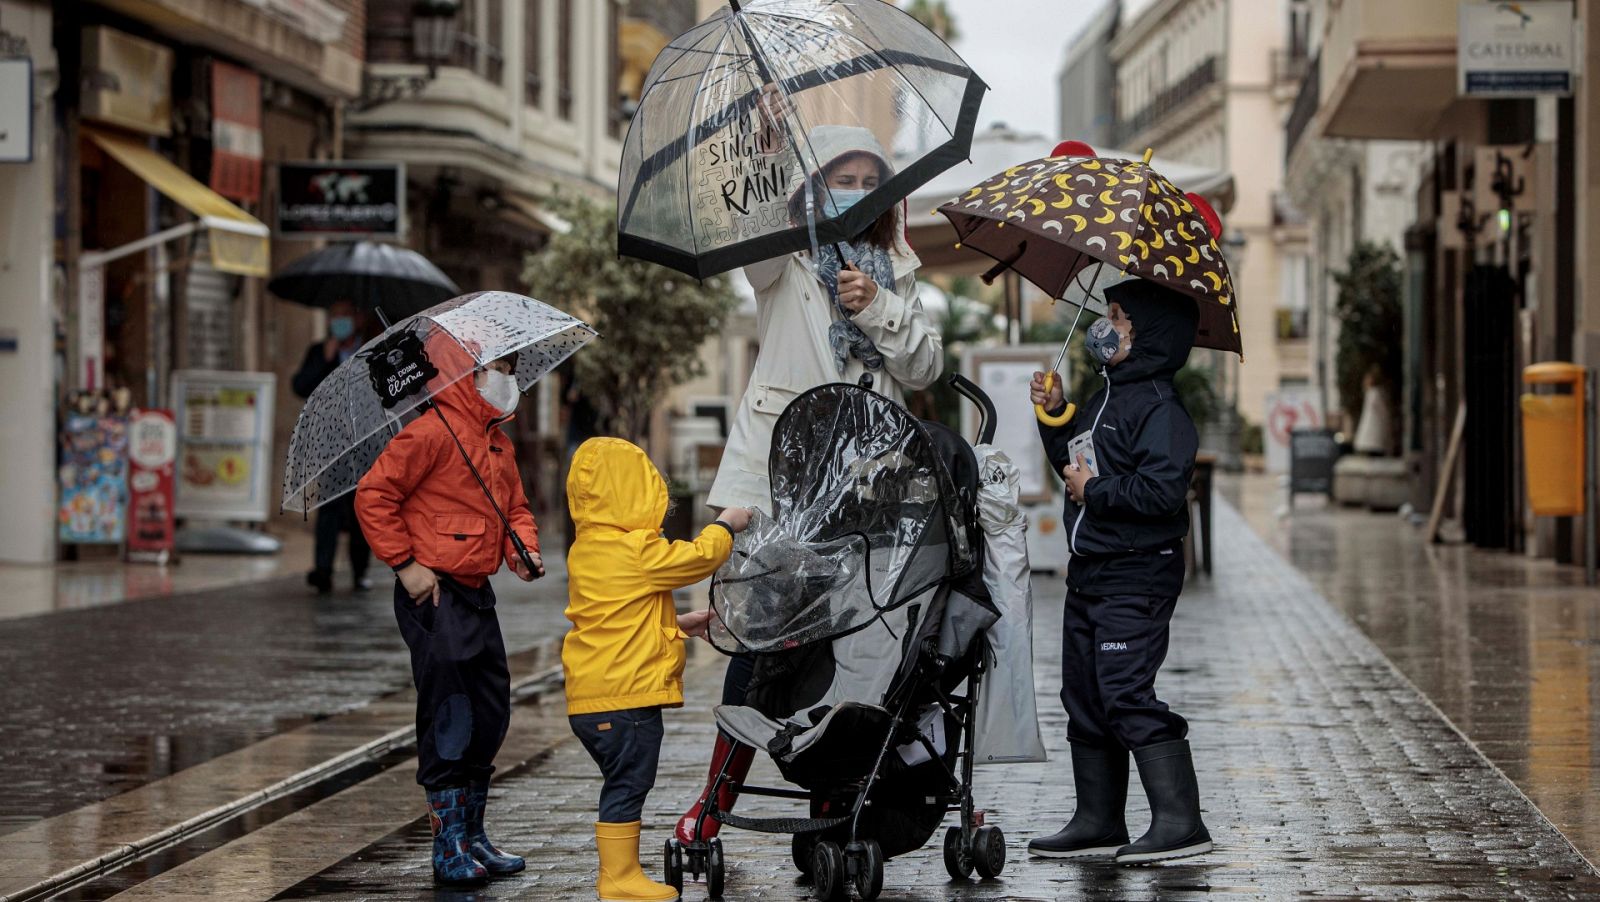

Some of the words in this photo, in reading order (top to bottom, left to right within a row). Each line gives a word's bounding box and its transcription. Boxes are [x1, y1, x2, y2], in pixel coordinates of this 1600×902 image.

[1467, 41, 1565, 60] CATEDRAL
[728, 112, 752, 138] I'M
[730, 161, 743, 179] IN
[751, 156, 768, 172] THE
[721, 163, 787, 215] RAIN!
[387, 374, 397, 384] NO
[388, 370, 424, 397] llama
